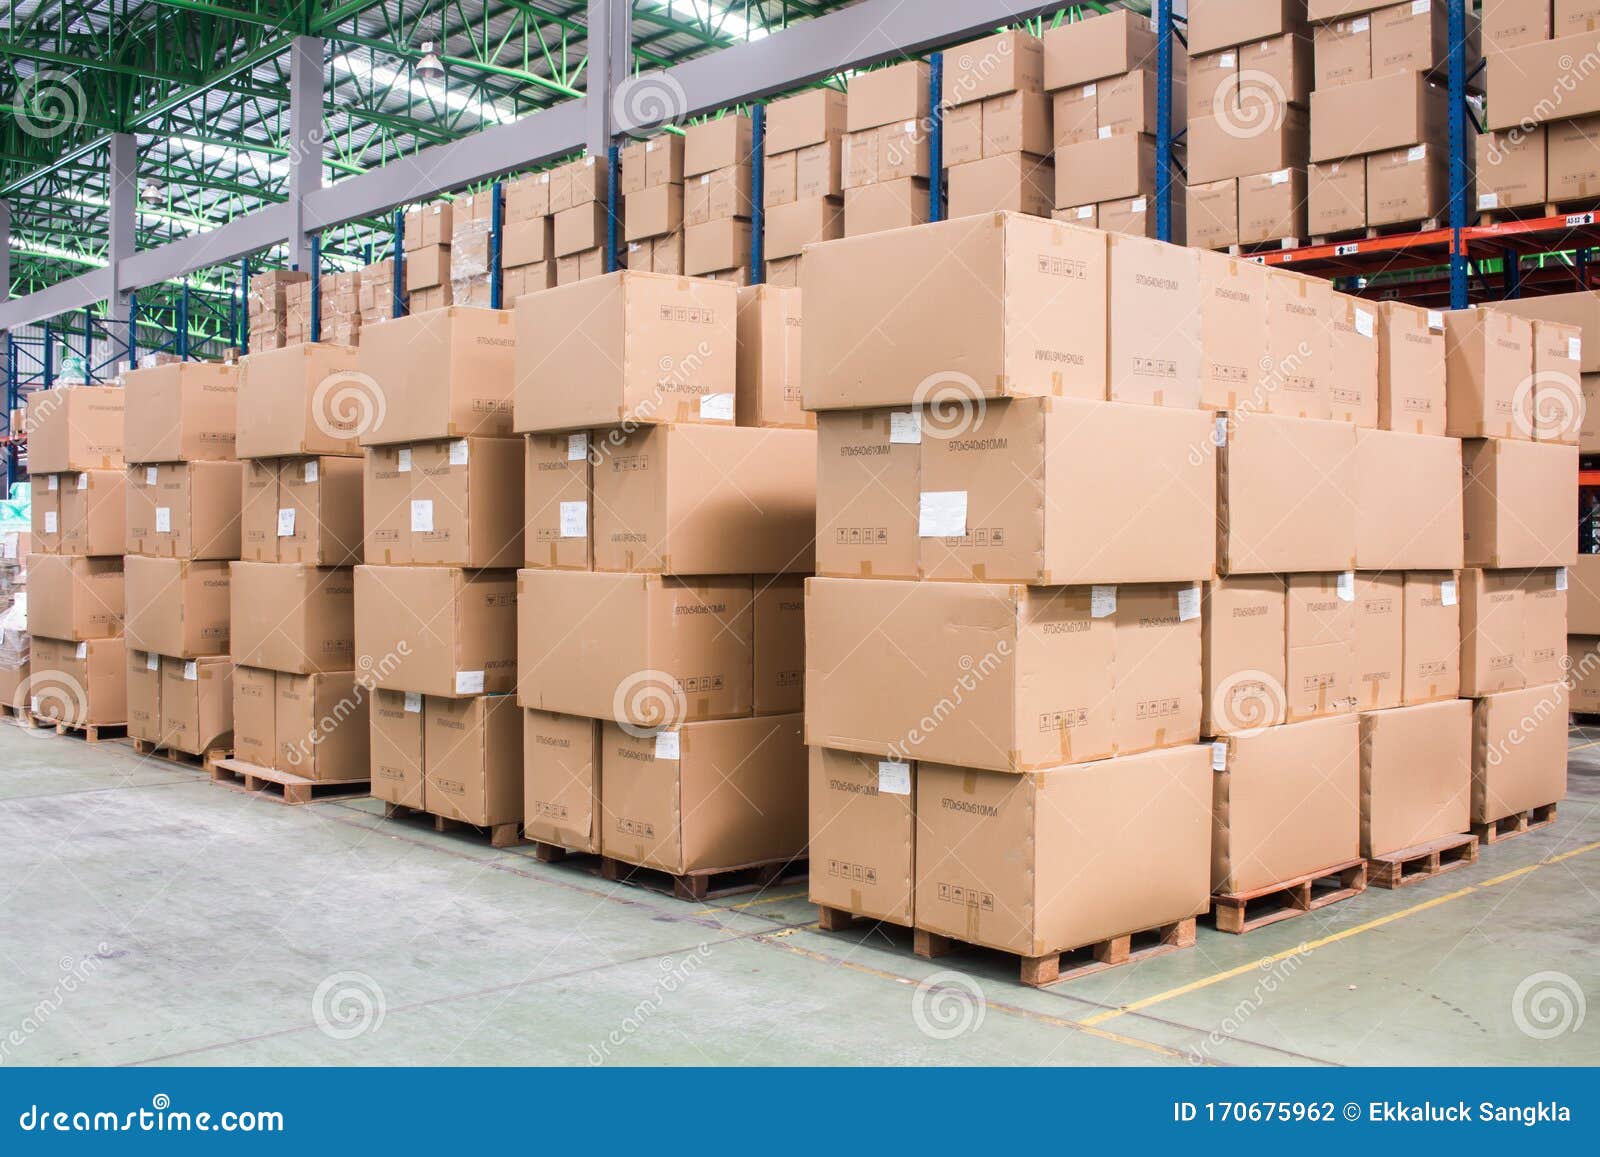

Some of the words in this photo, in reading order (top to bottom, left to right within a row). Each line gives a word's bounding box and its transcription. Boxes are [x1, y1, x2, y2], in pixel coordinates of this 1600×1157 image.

[840, 445, 891, 457] 970x540x610MM
[949, 438, 1009, 452] 970x540x610MM
[676, 601, 726, 615] 970x540x610MM
[1043, 621, 1093, 635] 970x540x610MM
[830, 779, 879, 796] 970x540x610MM
[942, 797, 998, 817] 970x540x610MM
